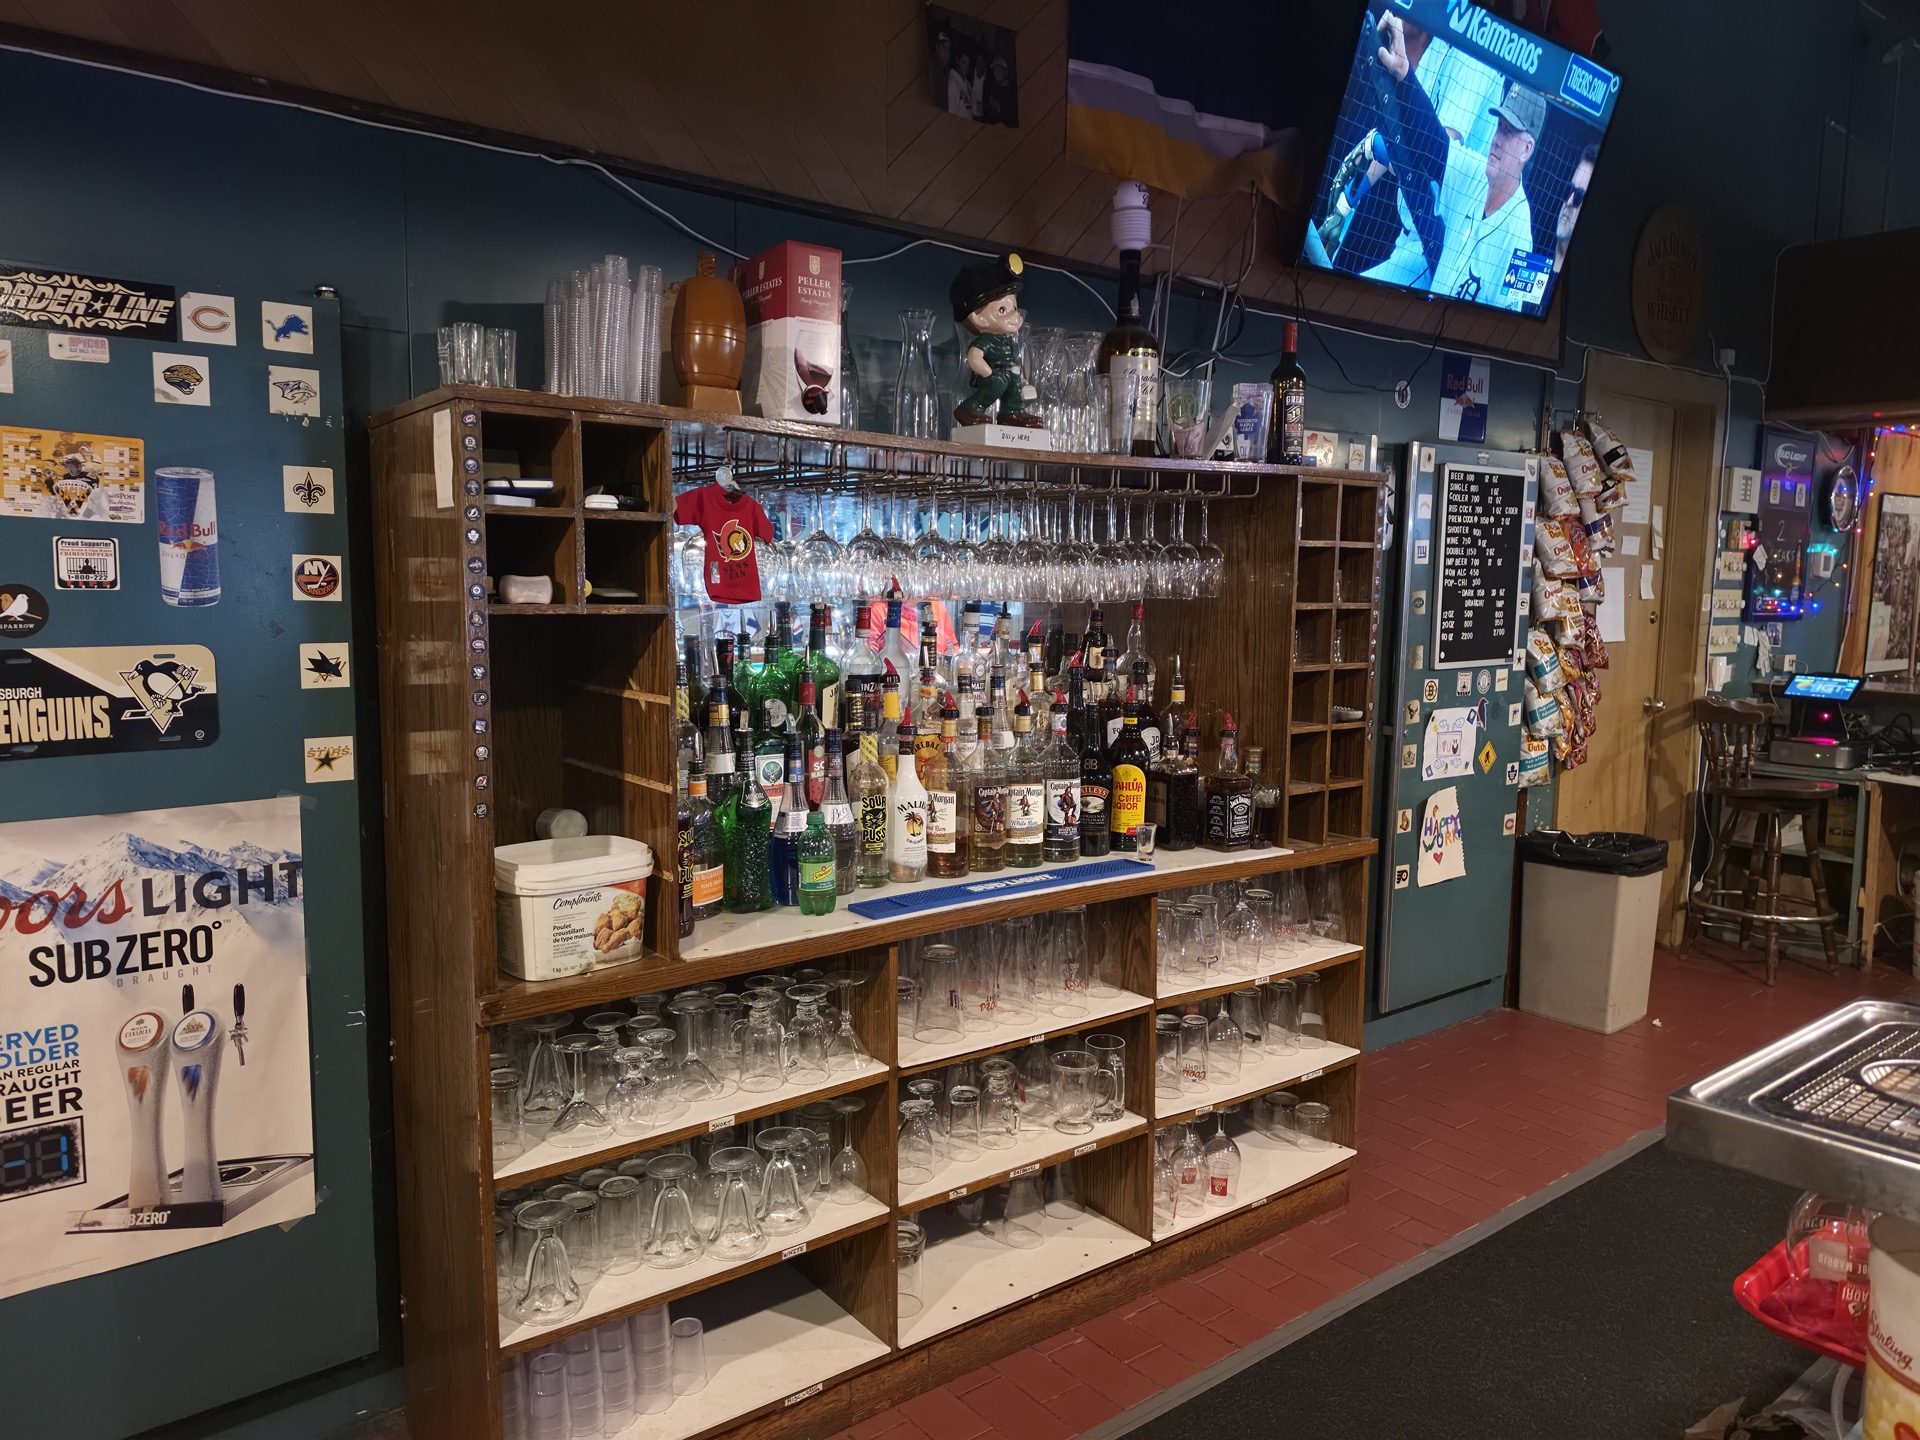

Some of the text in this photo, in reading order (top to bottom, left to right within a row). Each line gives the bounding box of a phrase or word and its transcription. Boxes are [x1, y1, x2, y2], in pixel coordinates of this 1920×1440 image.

[1466, 7, 1543, 75] Karmanos
[1567, 64, 1607, 105] TIGERS.COM
[798, 276, 832, 289] PELLER
[798, 286, 832, 298] ESTATES
[103, 294, 175, 324] LINE
[1446, 373, 1484, 394] Red Bull
[1778, 449, 1807, 461] BUD LIGHT
[1450, 472, 1464, 480] BEER
[1450, 483, 1468, 491] SINGLE
[1449, 492, 1468, 502] COOLER
[159, 520, 216, 538] Red Bull
[724, 561, 749, 573] SENS
[730, 570, 746, 581] FAN
[1472, 578, 1481, 586] 300
[1050, 782, 1068, 790] Captain
[861, 795, 886, 808] SOUR
[1118, 794, 1142, 803] COFFEE
[1424, 814, 1460, 836] HAPPY
[862, 828, 886, 841] PUSS
[141, 861, 303, 917] LIGHT
[553, 891, 602, 910] Compliments
[553, 928, 584, 938] croustillant
[116, 964, 214, 988] DRAUGHT
[0, 1024, 79, 1052] RVED
[124, 1028, 152, 1039] CANADIAN
[17, 1059, 80, 1078] REGULAR
[711, 1119, 733, 1130] SHORT
[783, 1246, 805, 1258] WHITE
